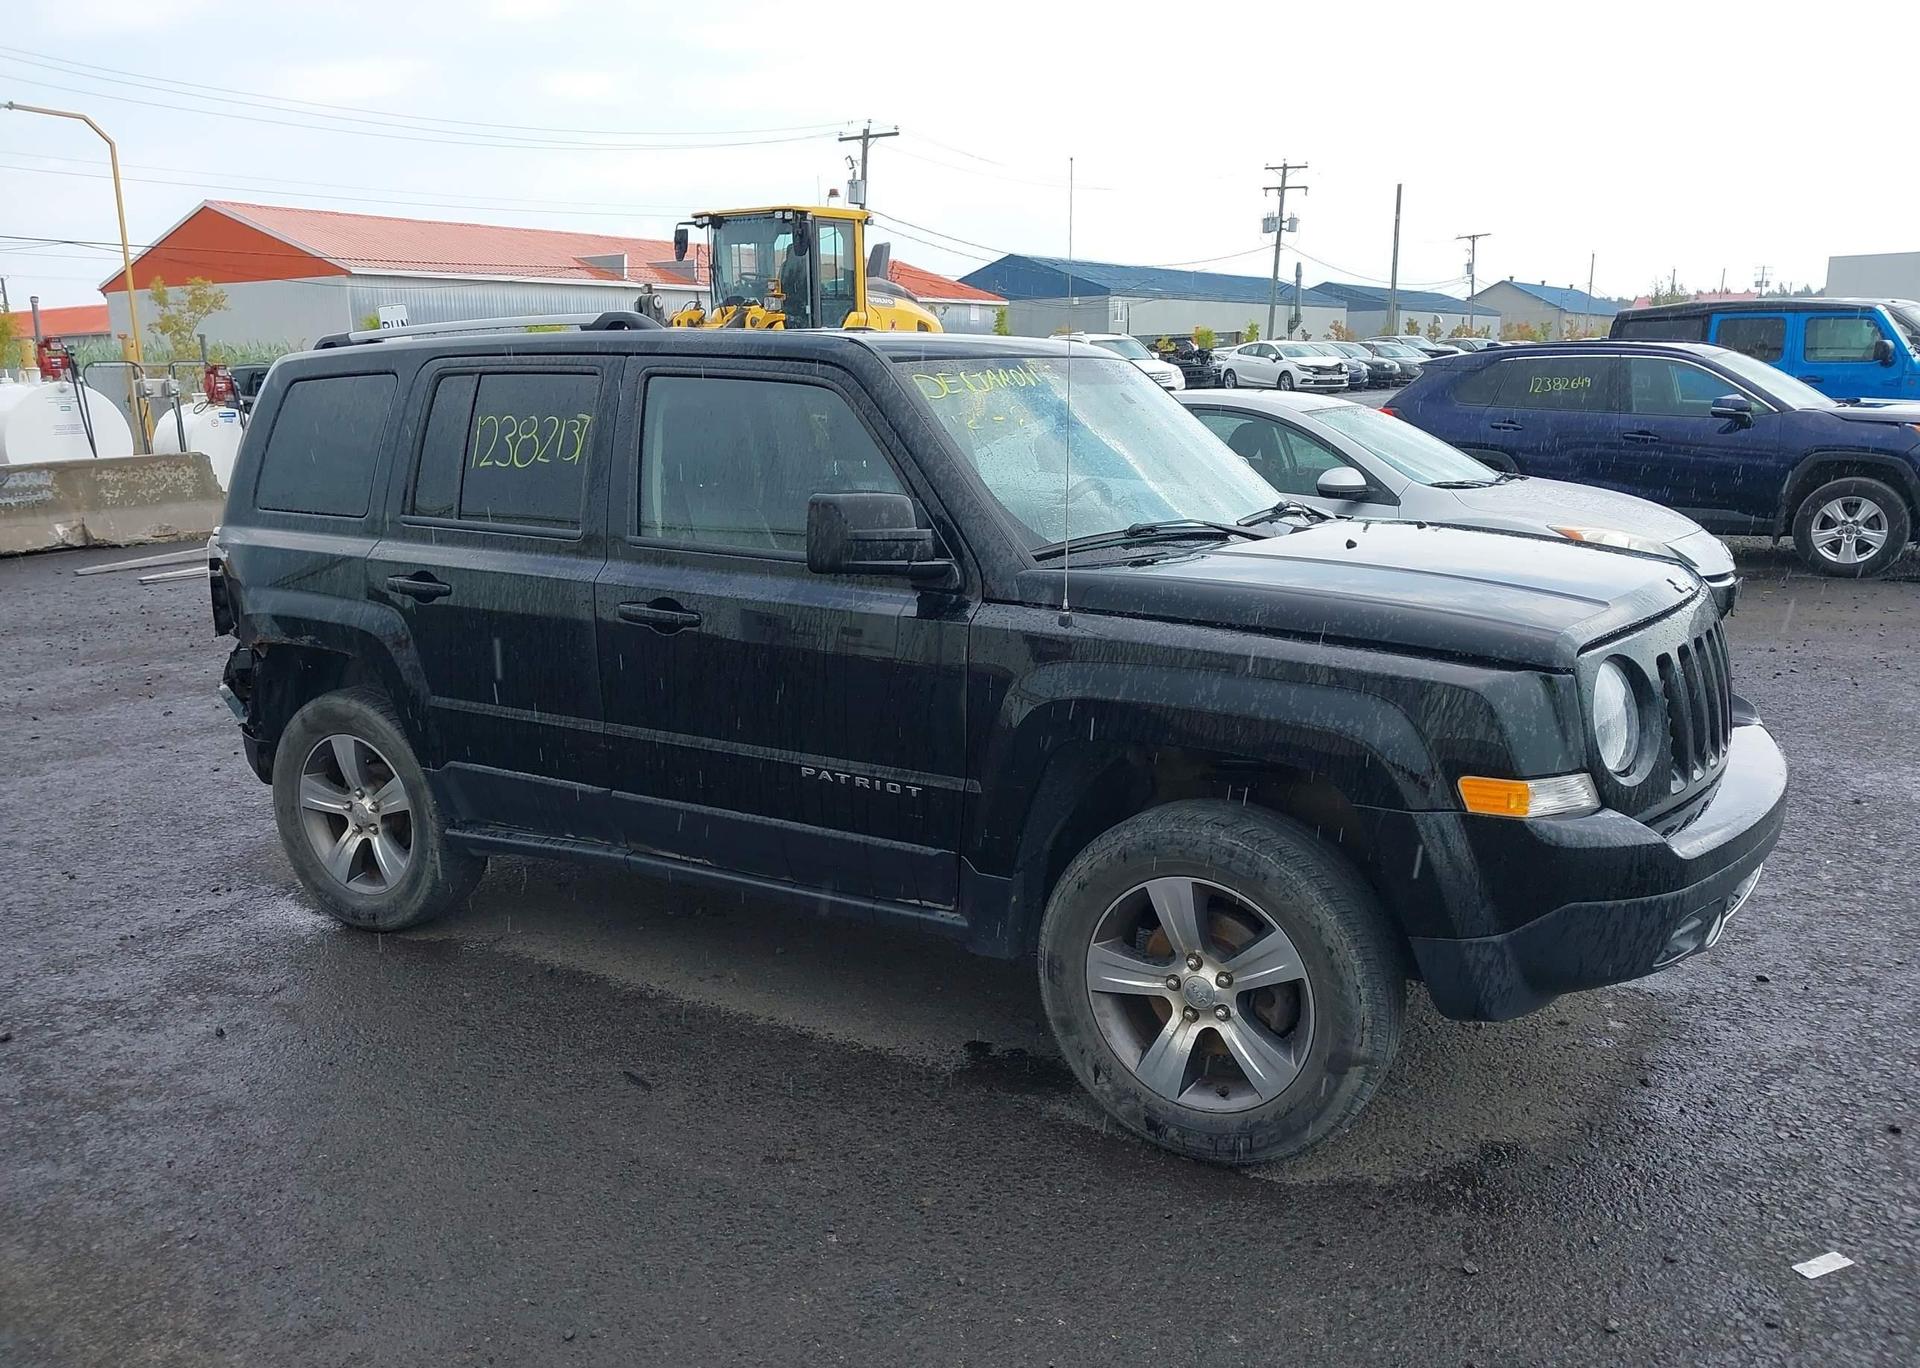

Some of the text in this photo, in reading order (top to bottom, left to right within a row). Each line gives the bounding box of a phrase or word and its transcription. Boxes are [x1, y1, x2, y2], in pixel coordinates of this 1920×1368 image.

[1529, 376, 1591, 393] 12382649
[472, 414, 592, 468] 12382137
[800, 766, 923, 798] PATRIOT
